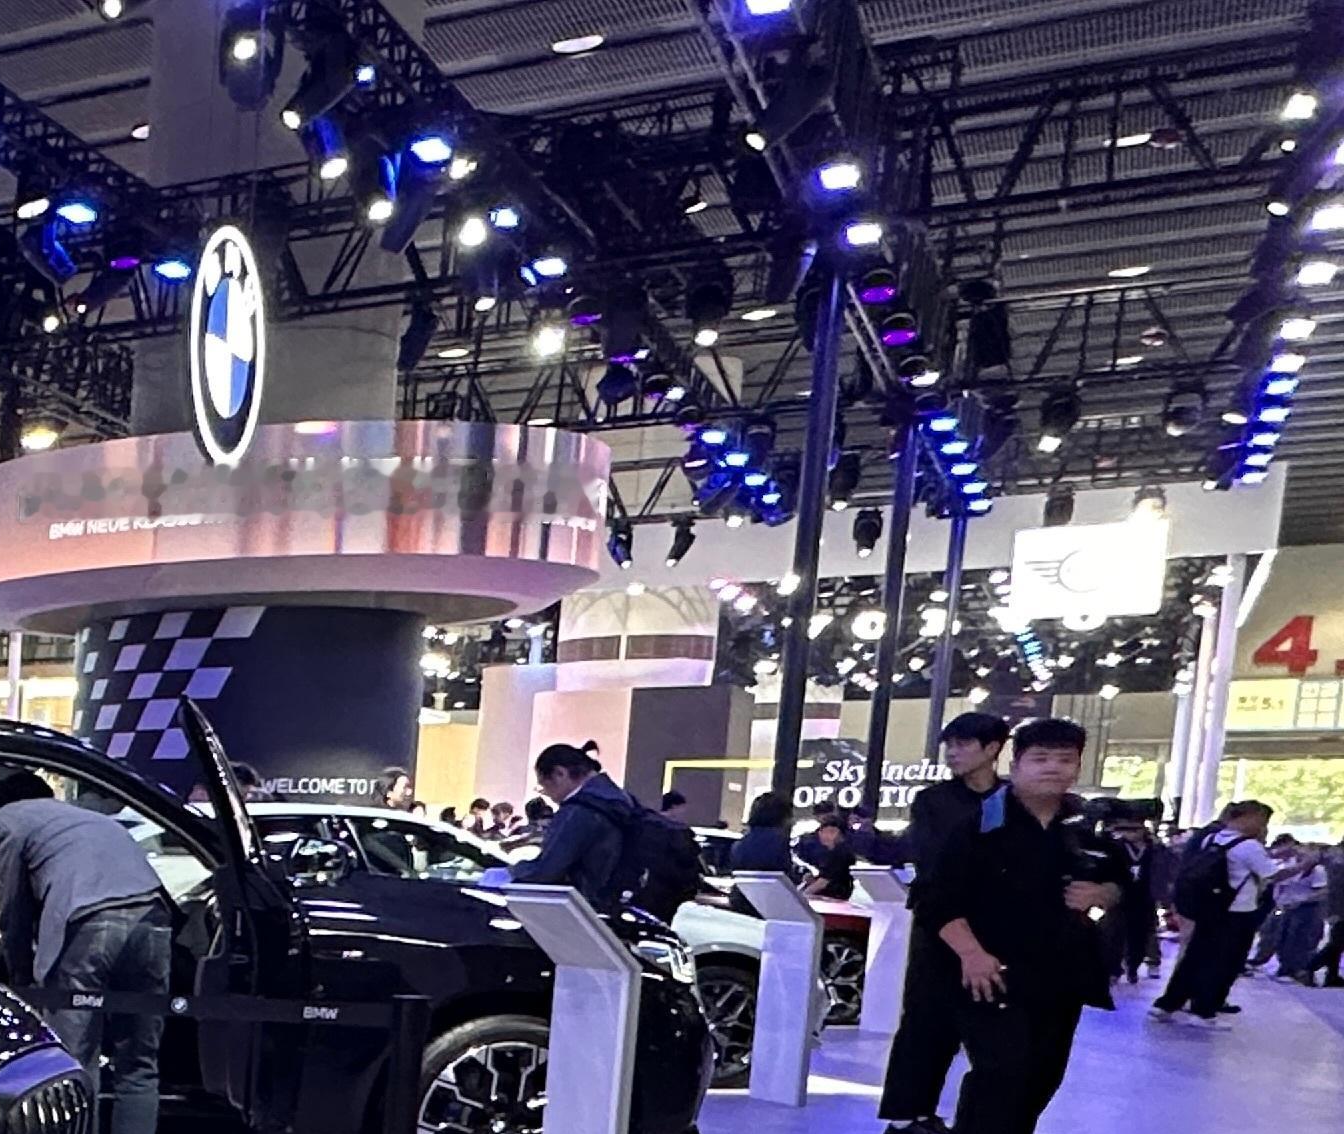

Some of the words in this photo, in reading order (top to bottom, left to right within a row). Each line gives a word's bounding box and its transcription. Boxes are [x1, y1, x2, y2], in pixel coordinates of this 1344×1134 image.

[262, 777, 345, 795] WELCOME
[346, 778, 367, 795] TO
[72, 993, 105, 1008] BMW
[302, 1006, 338, 1021] BMW
